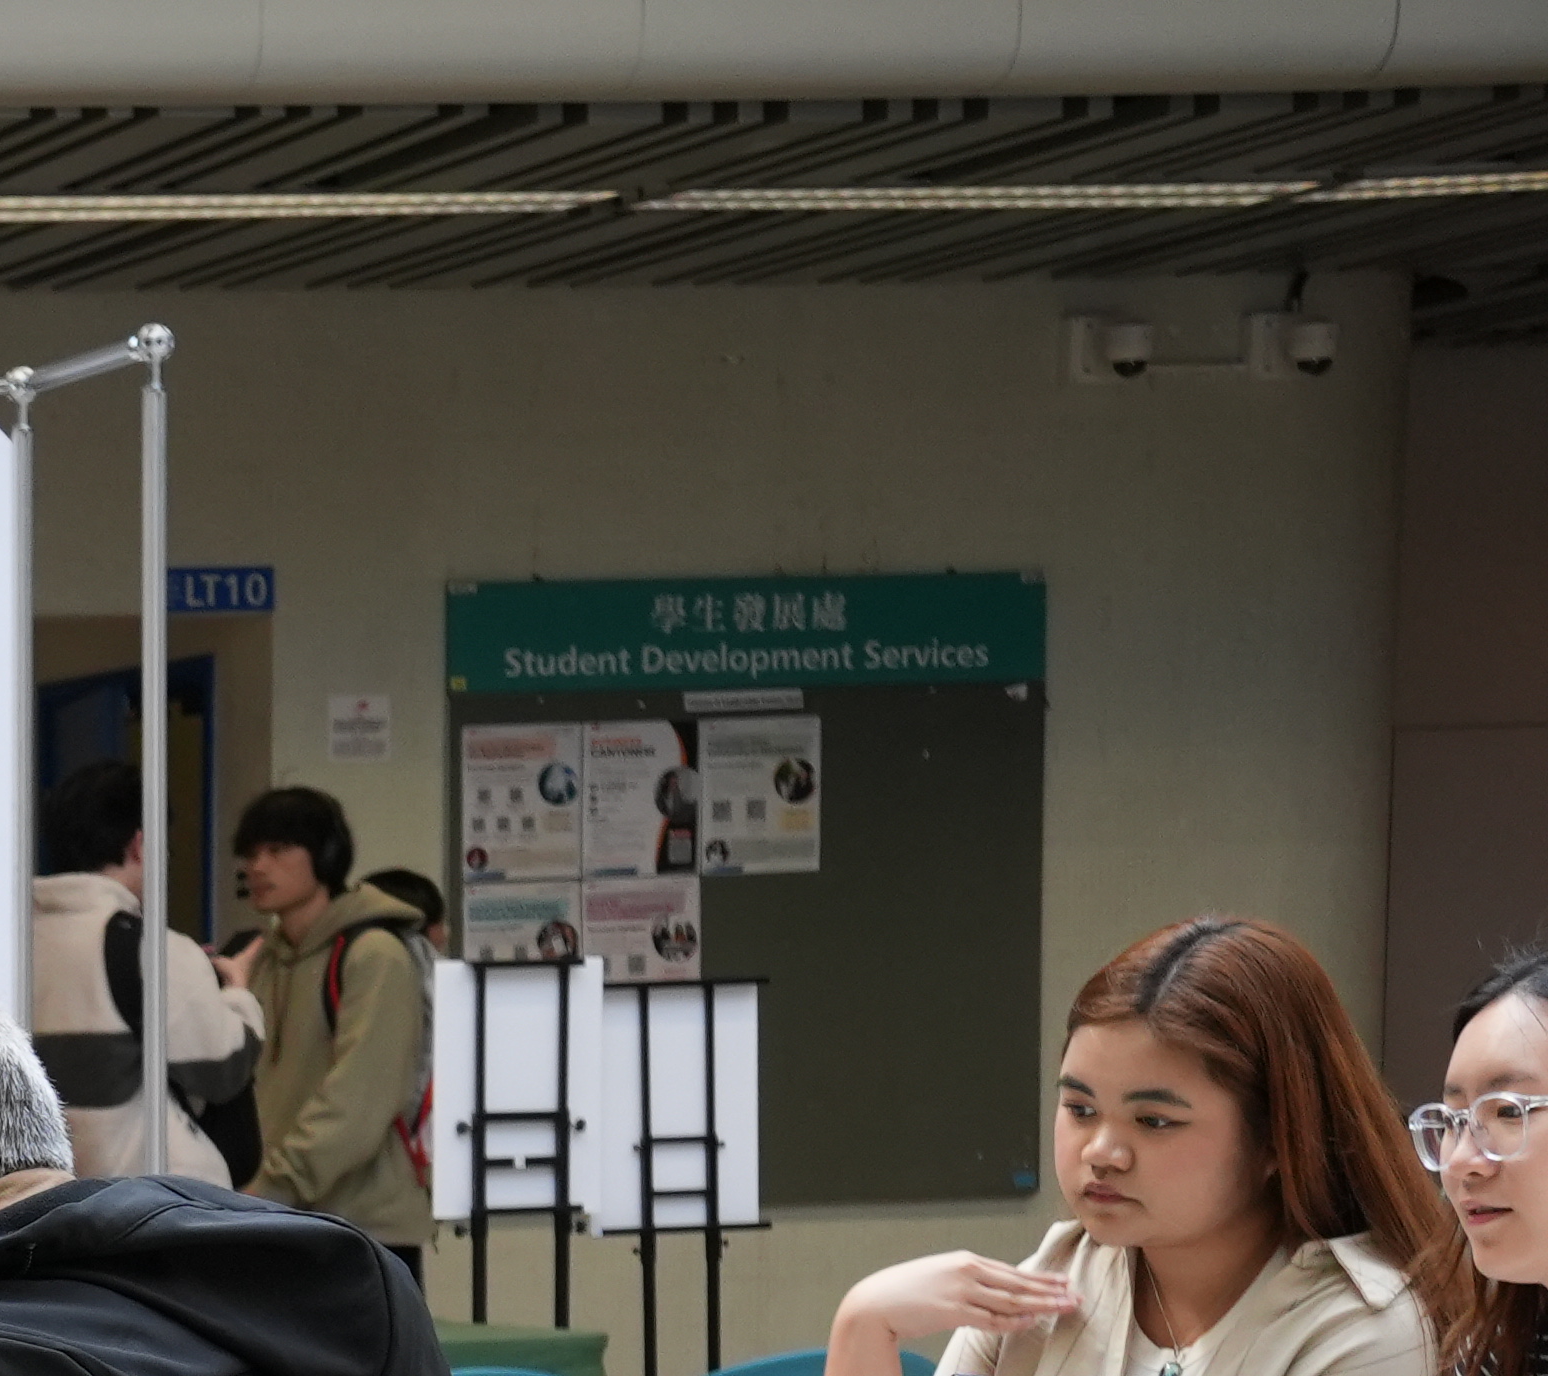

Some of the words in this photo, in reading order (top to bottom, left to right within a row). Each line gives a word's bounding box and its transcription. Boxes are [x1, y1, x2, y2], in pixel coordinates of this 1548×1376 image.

[184, 572, 268, 608] LT10
[650, 590, 848, 635] 學生發展處
[504, 644, 632, 679] Student
[642, 641, 855, 680] Development
[863, 637, 989, 670] Services
